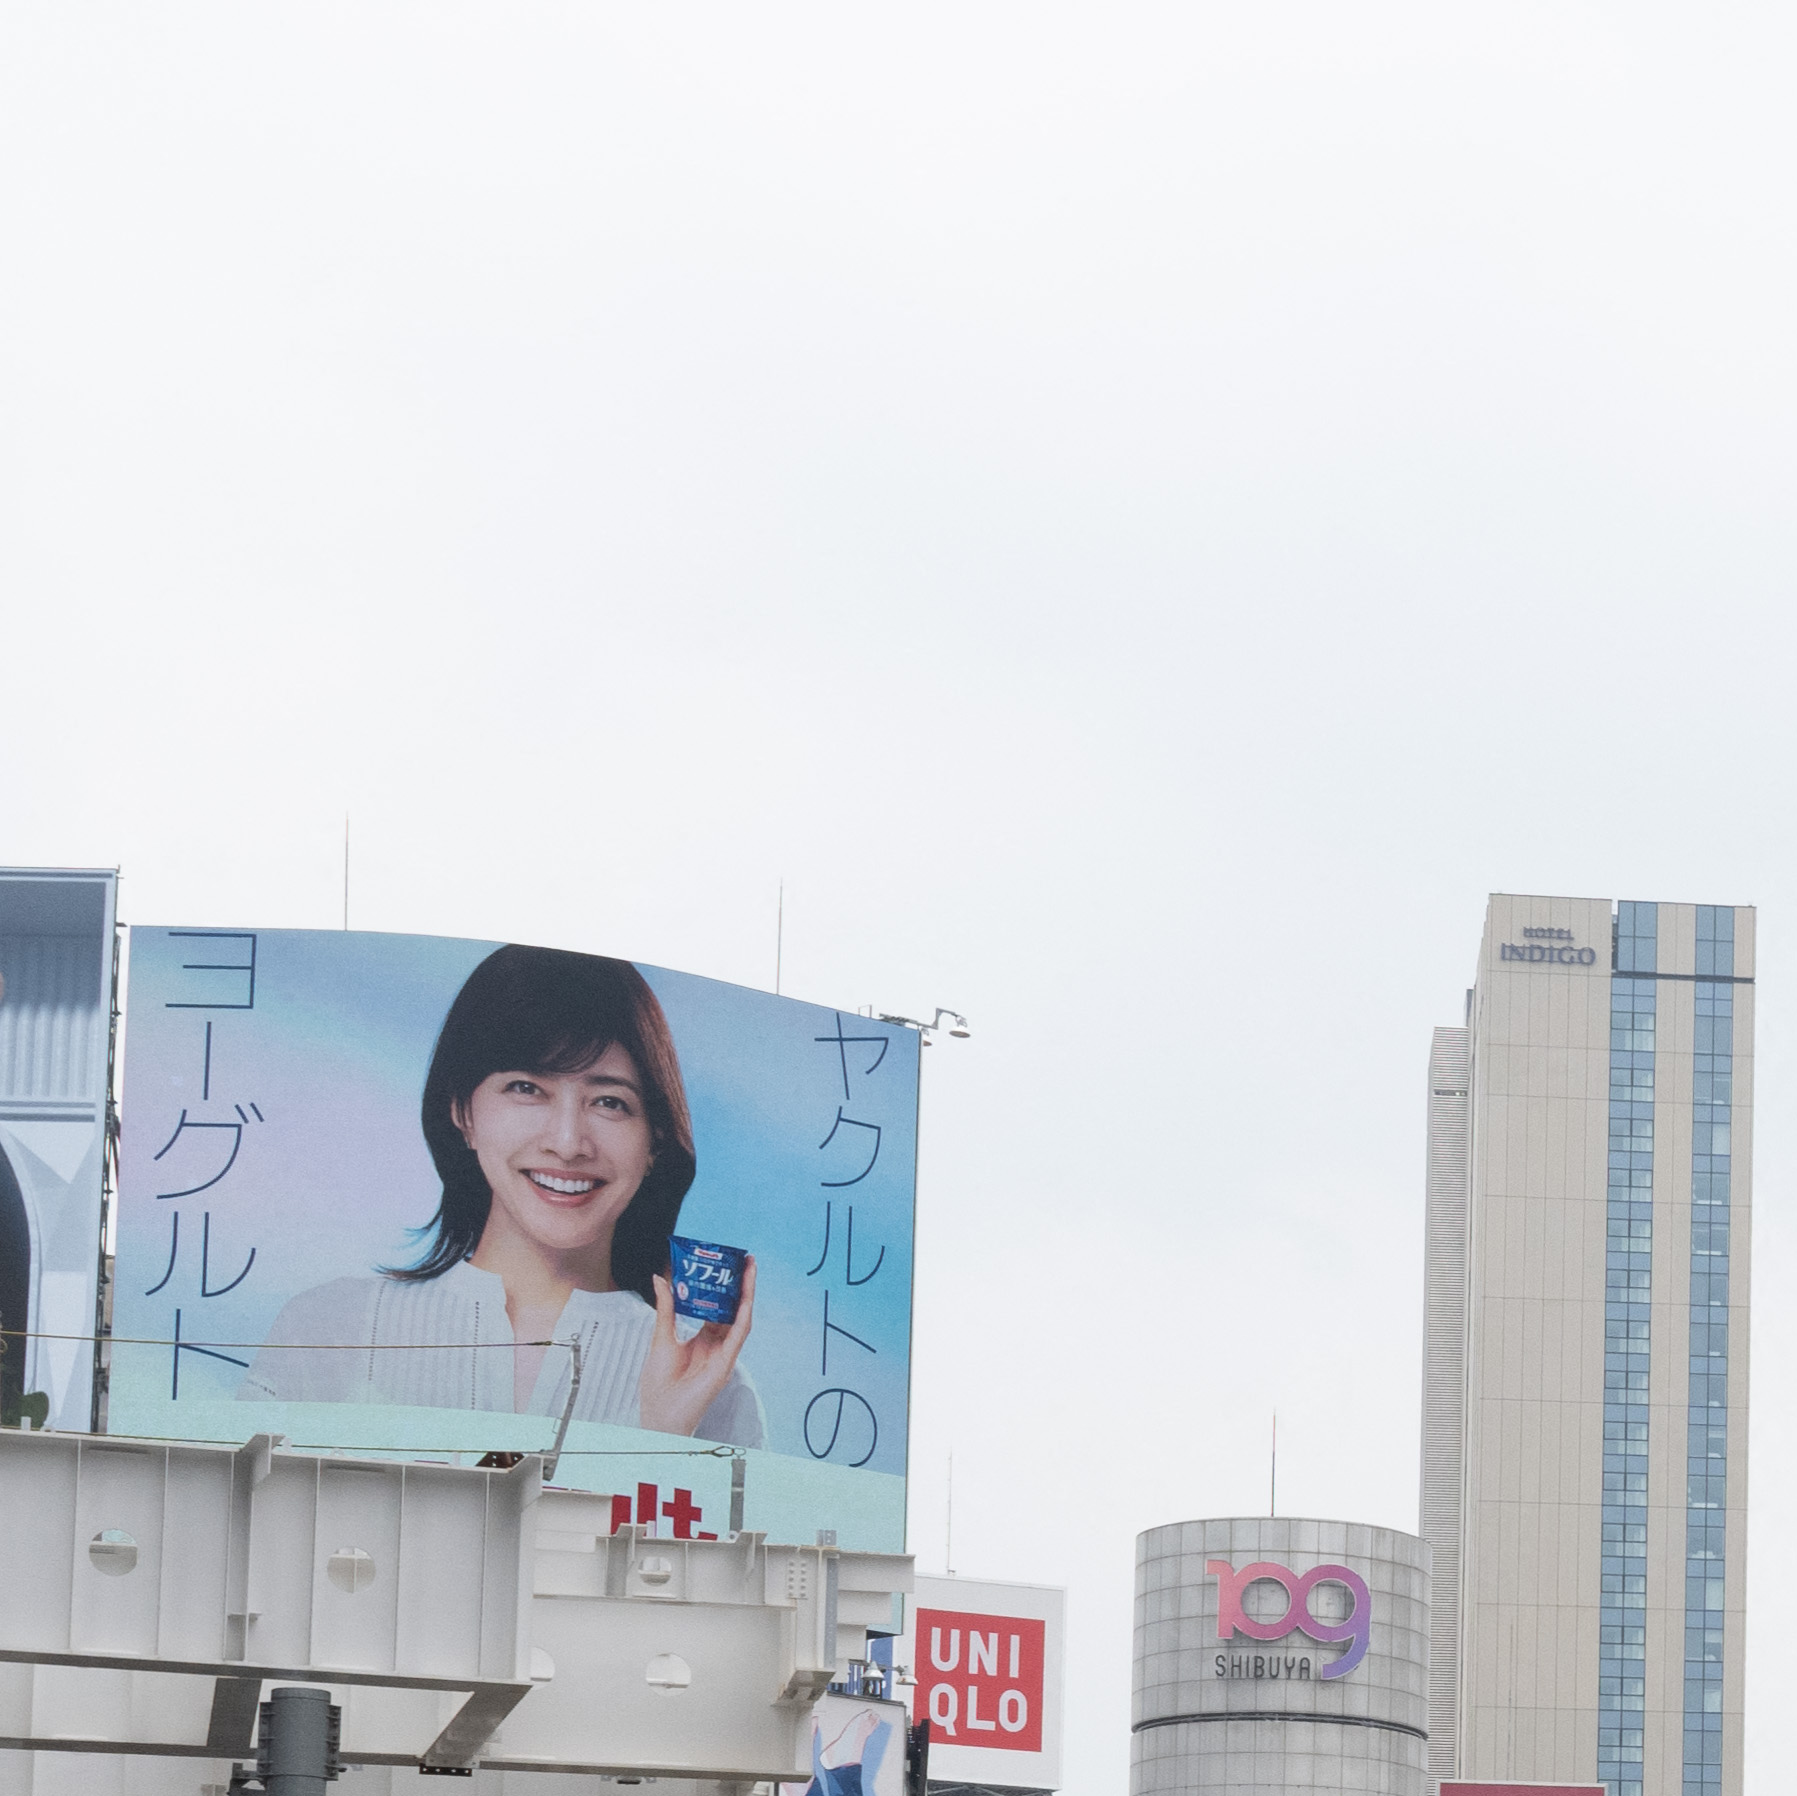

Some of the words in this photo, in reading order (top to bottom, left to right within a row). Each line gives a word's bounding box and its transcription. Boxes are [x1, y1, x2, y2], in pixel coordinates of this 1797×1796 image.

[1500, 942, 1597, 967] INDIGO
[1522, 926, 1575, 941] HOTEL
[146, 931, 257, 1401] ヨーグルト
[805, 1012, 890, 1467] ヤクルトの
[1206, 1559, 1372, 1680] 109
[930, 1626, 1021, 1678] UNI
[1214, 1654, 1312, 1680] SHIBUYA
[929, 1684, 1029, 1737] QLO
